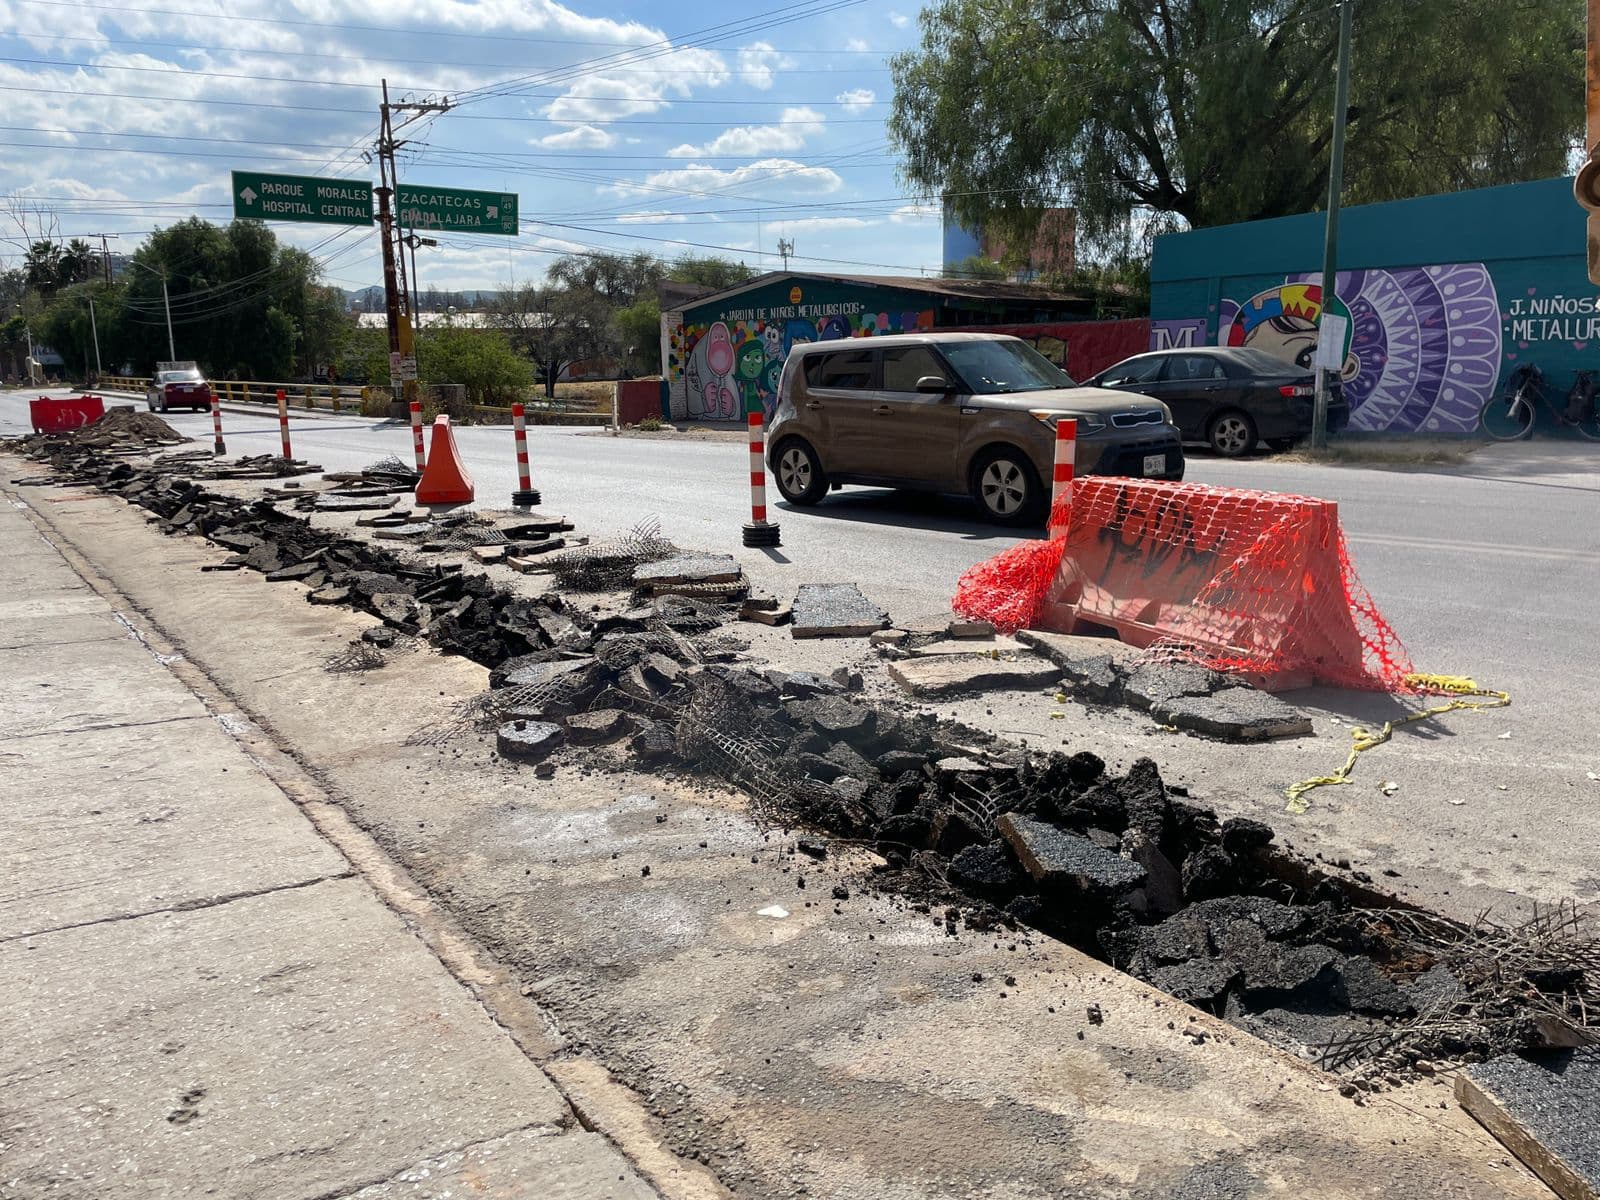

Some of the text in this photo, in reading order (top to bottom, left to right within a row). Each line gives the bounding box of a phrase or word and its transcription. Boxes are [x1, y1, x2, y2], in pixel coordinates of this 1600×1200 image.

[261, 182, 368, 201] PARQUE MORALES
[400, 192, 481, 209] ZACATECAS
[262, 200, 369, 218] HOSPITAL CENTRAL
[401, 208, 481, 226] GUADALAJARA
[726, 302, 861, 321] JARDIN DE NIÑOS METALURGICOS
[1509, 299, 1526, 316] J.
